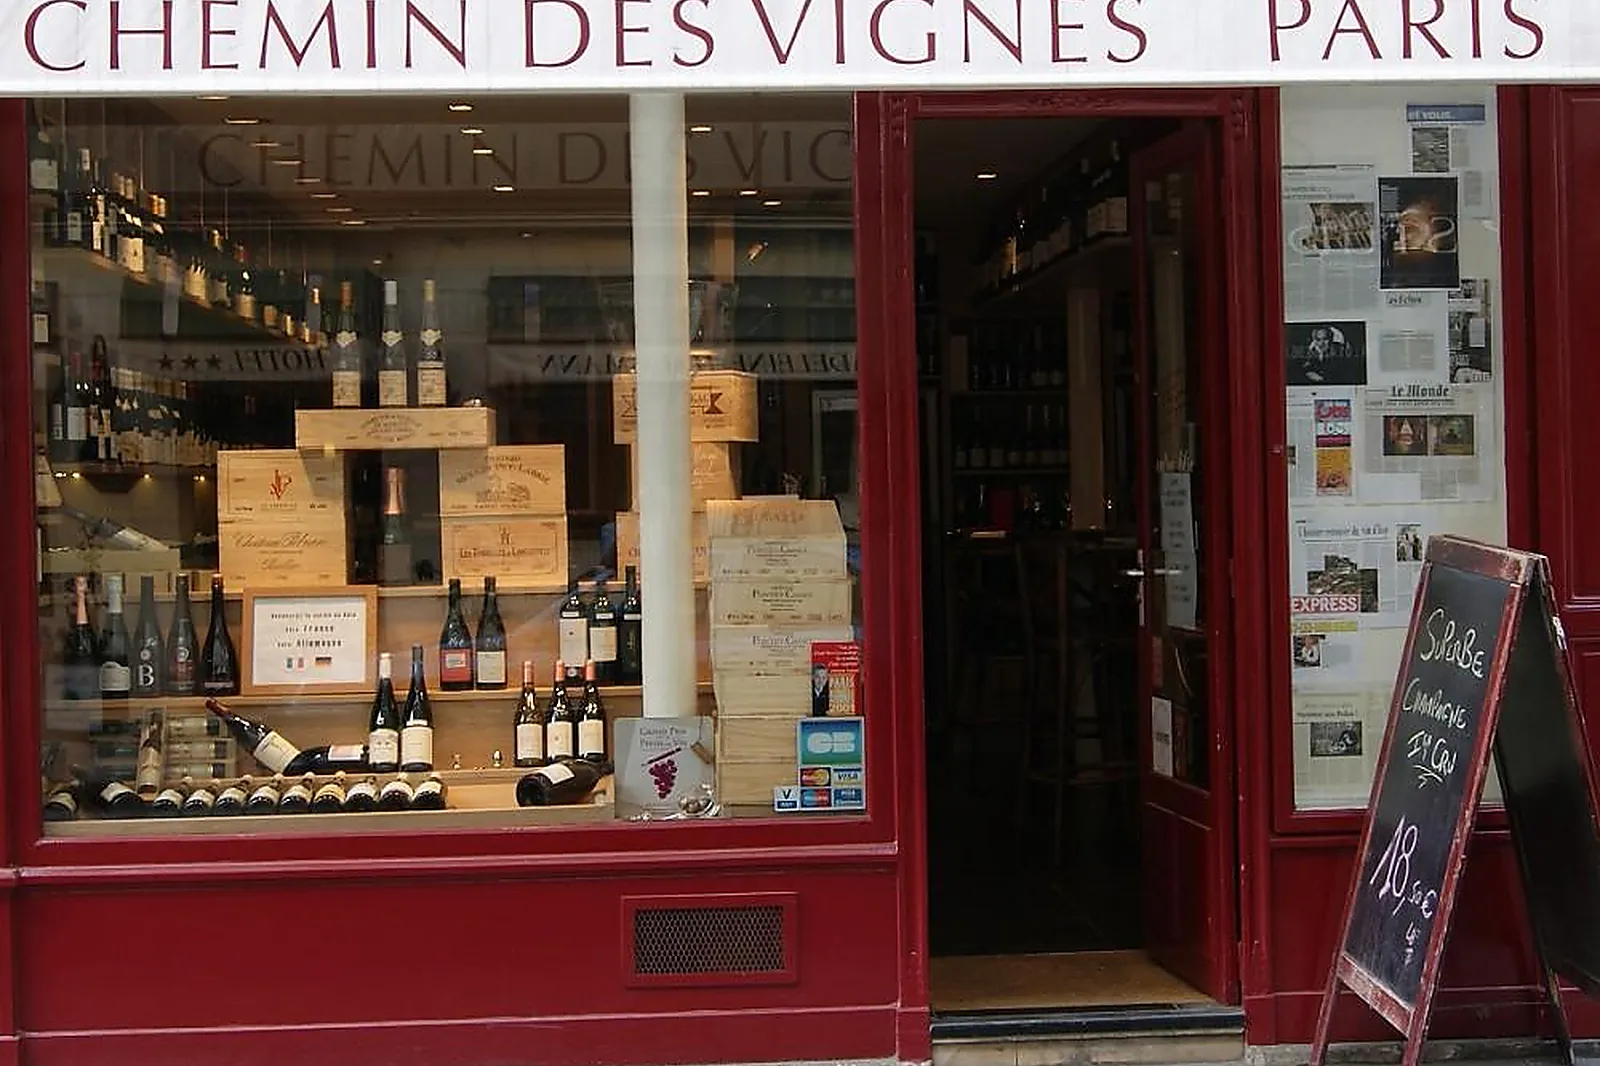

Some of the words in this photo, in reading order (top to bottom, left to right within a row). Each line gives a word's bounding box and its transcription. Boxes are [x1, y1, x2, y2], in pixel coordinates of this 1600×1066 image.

[23, 0, 468, 71] CHEMIN
[524, 0, 714, 68] DES
[751, 0, 1147, 65] VIGNES
[1266, 0, 1544, 61] PARIS
[1406, 384, 1450, 397] Monde
[1292, 597, 1358, 612] EXPRESS
[1419, 607, 1486, 679] SUPERBE
